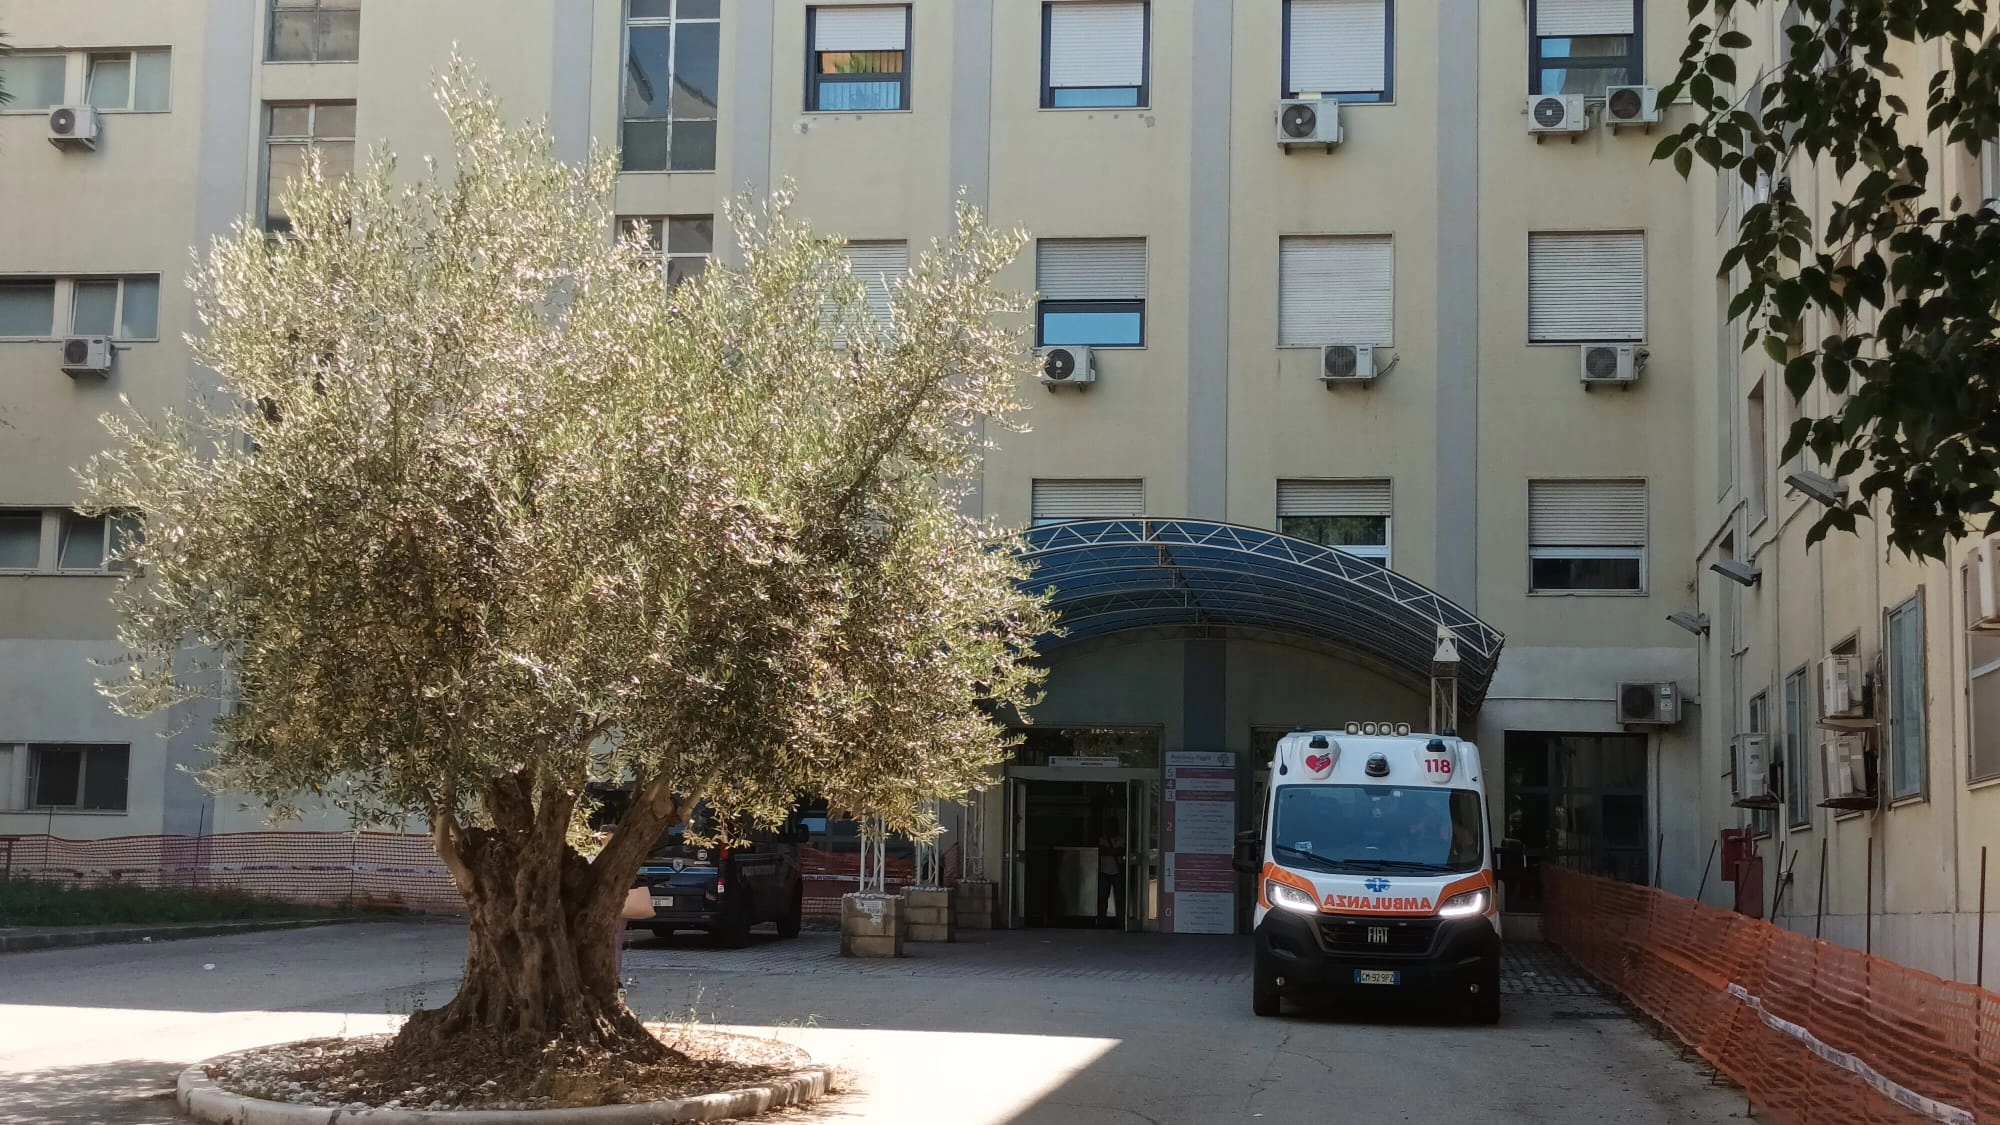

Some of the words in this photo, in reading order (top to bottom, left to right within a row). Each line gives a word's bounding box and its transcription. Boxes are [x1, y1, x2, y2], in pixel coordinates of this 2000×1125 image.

[1424, 758, 1451, 774] 118
[1167, 768, 1174, 778] 5
[1166, 779, 1174, 788] 4
[1167, 790, 1173, 800] 3
[1166, 821, 1173, 832] 2
[1167, 868, 1172, 877] 1
[1165, 907, 1172, 917] 0
[1367, 926, 1390, 944] FIAT
